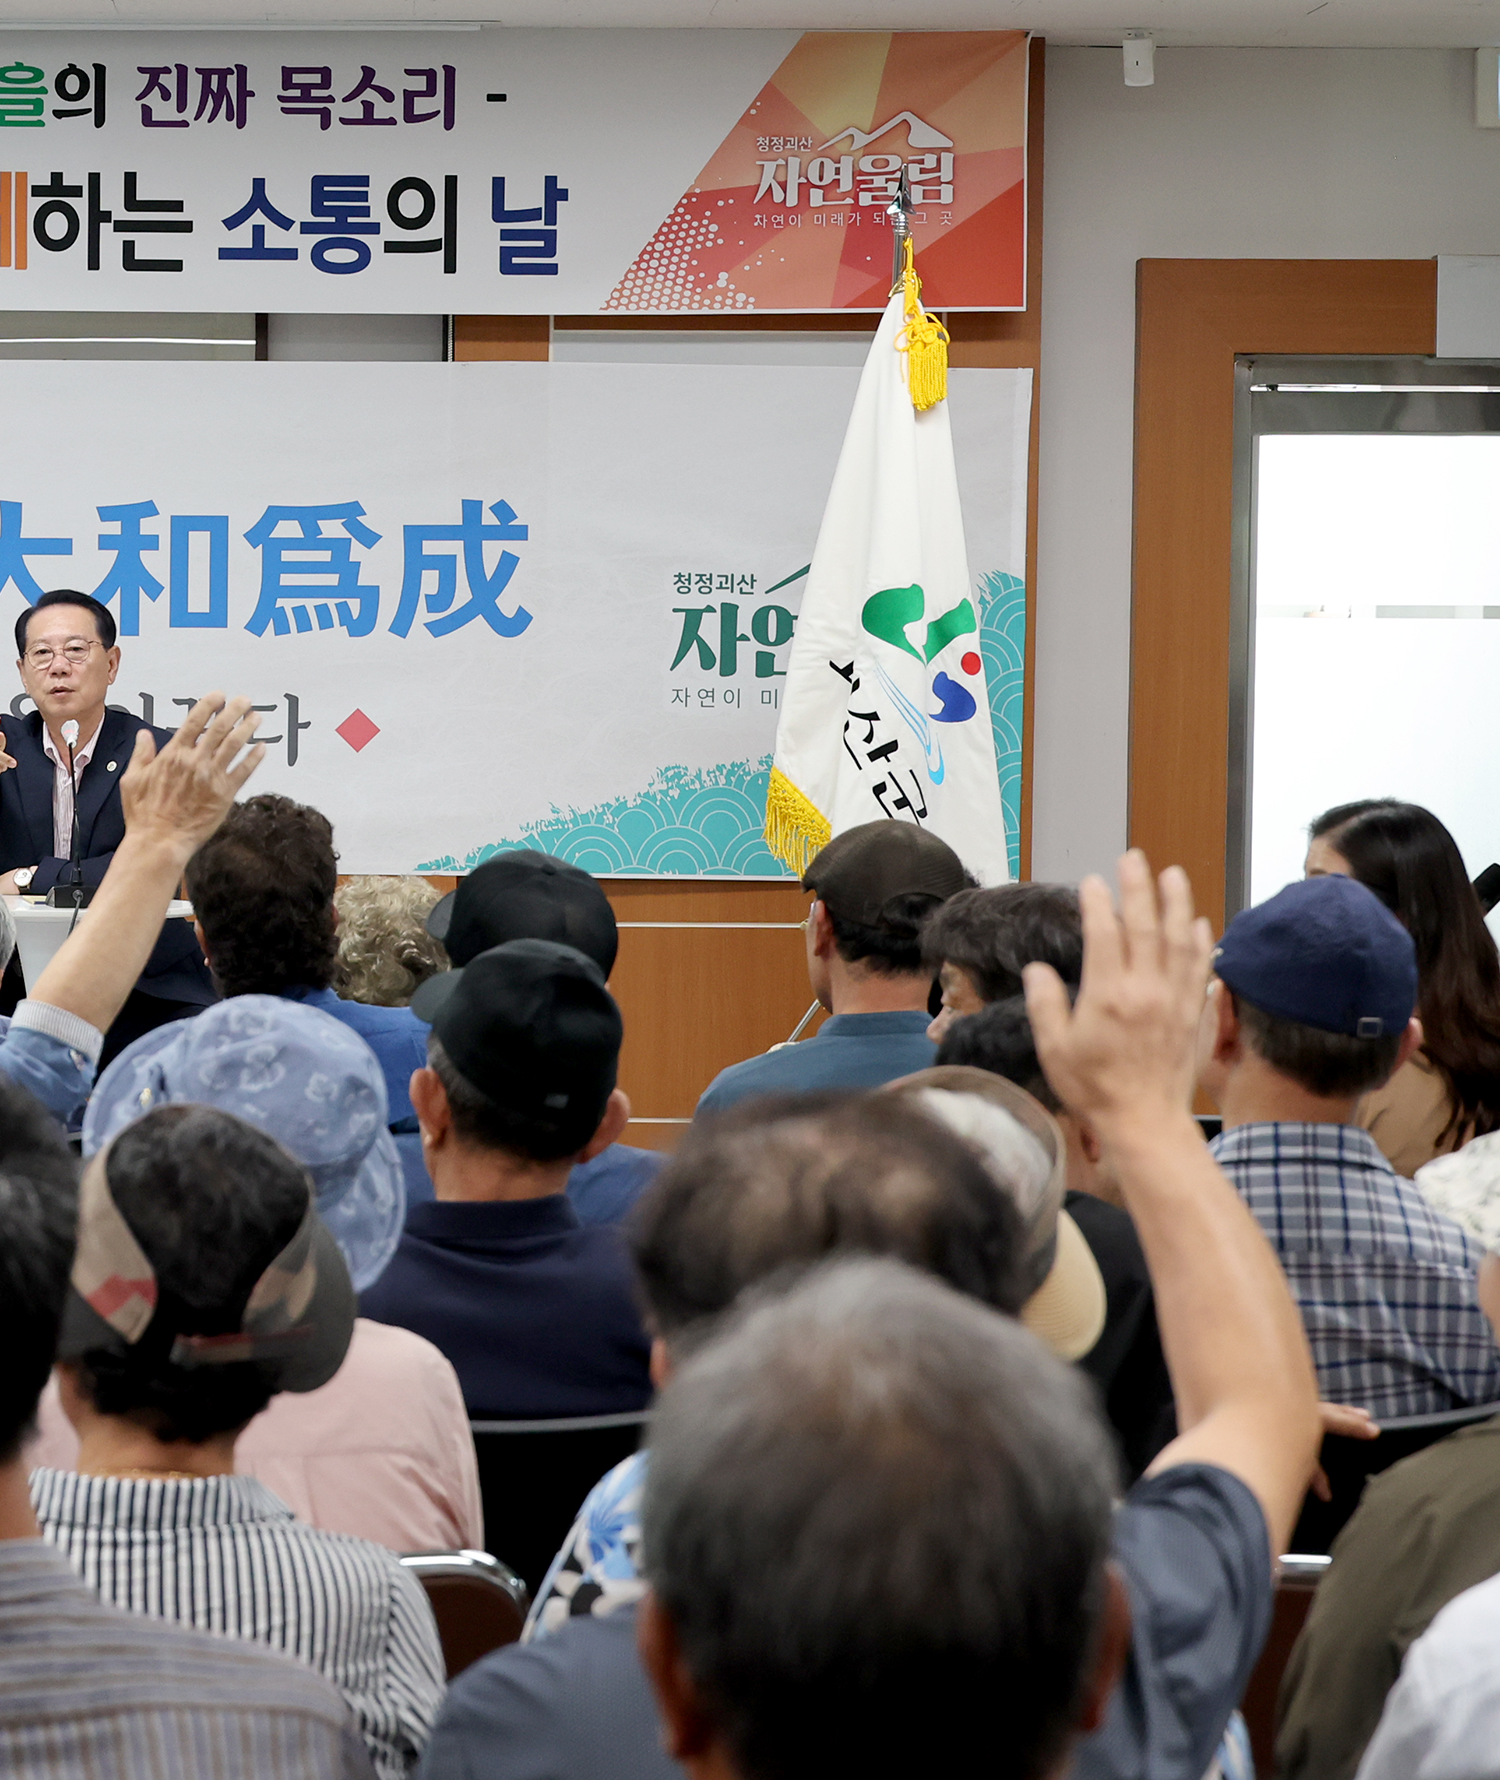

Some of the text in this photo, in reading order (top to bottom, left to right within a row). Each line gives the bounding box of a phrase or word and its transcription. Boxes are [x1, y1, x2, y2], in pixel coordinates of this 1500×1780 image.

[135, 63, 256, 130] 진짜
[276, 65, 457, 131] 목소리
[756, 136, 813, 152] 청정괴산
[753, 152, 954, 207] 자연울림
[217, 174, 459, 275] 소통의
[491, 174, 569, 276] 날
[754, 214, 801, 229] 자연이
[814, 212, 862, 227] 미래가
[915, 212, 928, 224] 그
[940, 211, 953, 225] 곳
[673, 572, 757, 595] 청정괴산
[670, 602, 798, 678] 자연
[671, 687, 741, 709] 자연이
